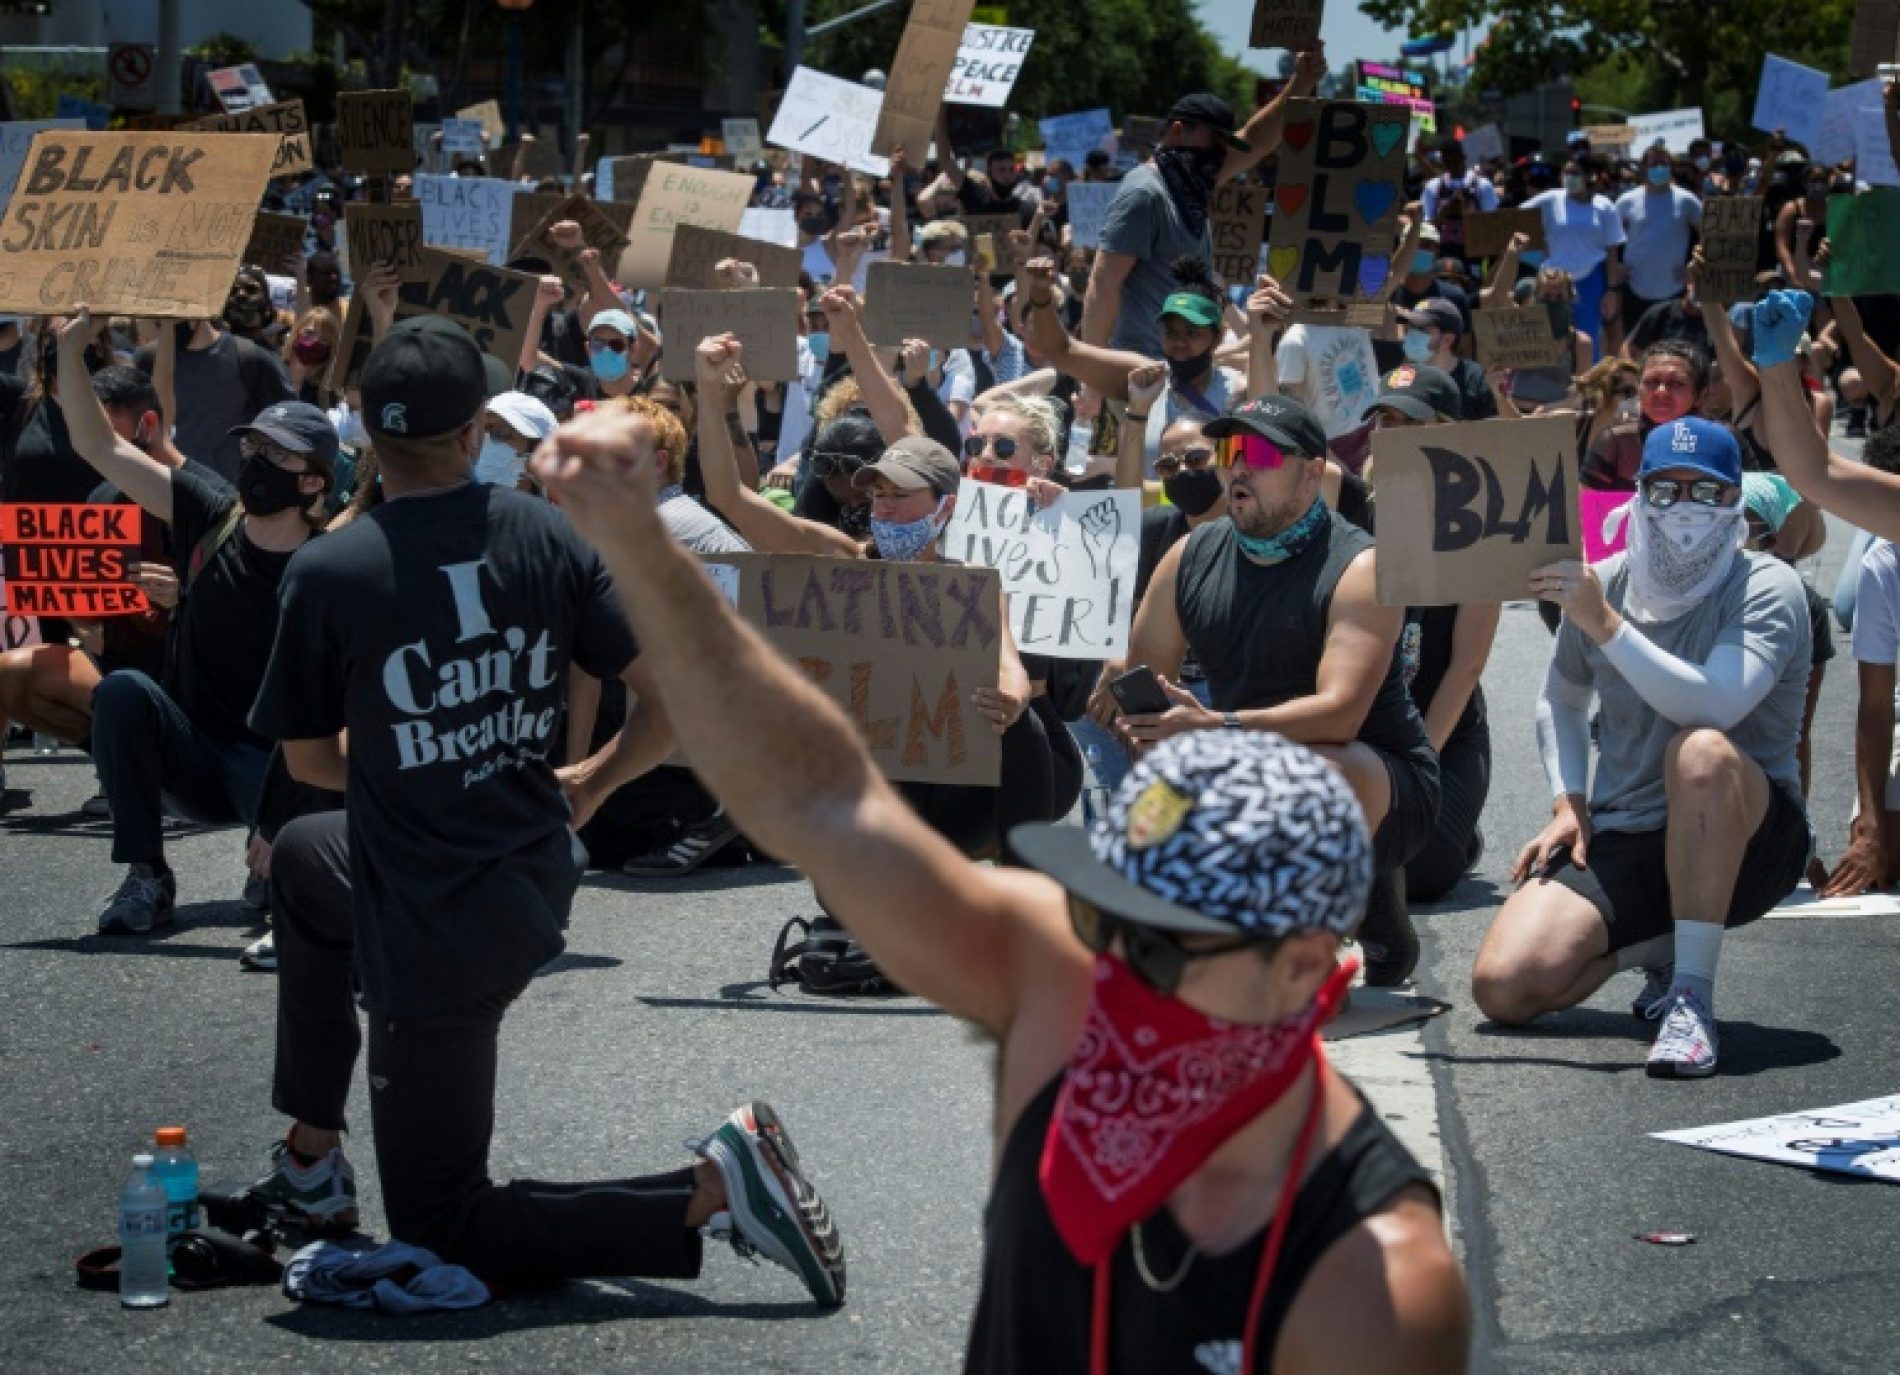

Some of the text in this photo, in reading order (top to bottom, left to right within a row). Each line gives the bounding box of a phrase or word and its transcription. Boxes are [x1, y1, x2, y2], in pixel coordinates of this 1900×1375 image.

[25, 145, 206, 195] BLACK
[422, 179, 500, 209] BLACK
[2, 200, 118, 252] SKIN
[16, 508, 127, 540] BLACK
[1419, 446, 1569, 552] BLM
[19, 547, 124, 580] LIVES
[13, 585, 142, 612] MATTER
[437, 557, 498, 644] I
[761, 567, 997, 650] LATINX
[382, 627, 558, 716] Can't
[391, 697, 556, 770] Breathe
